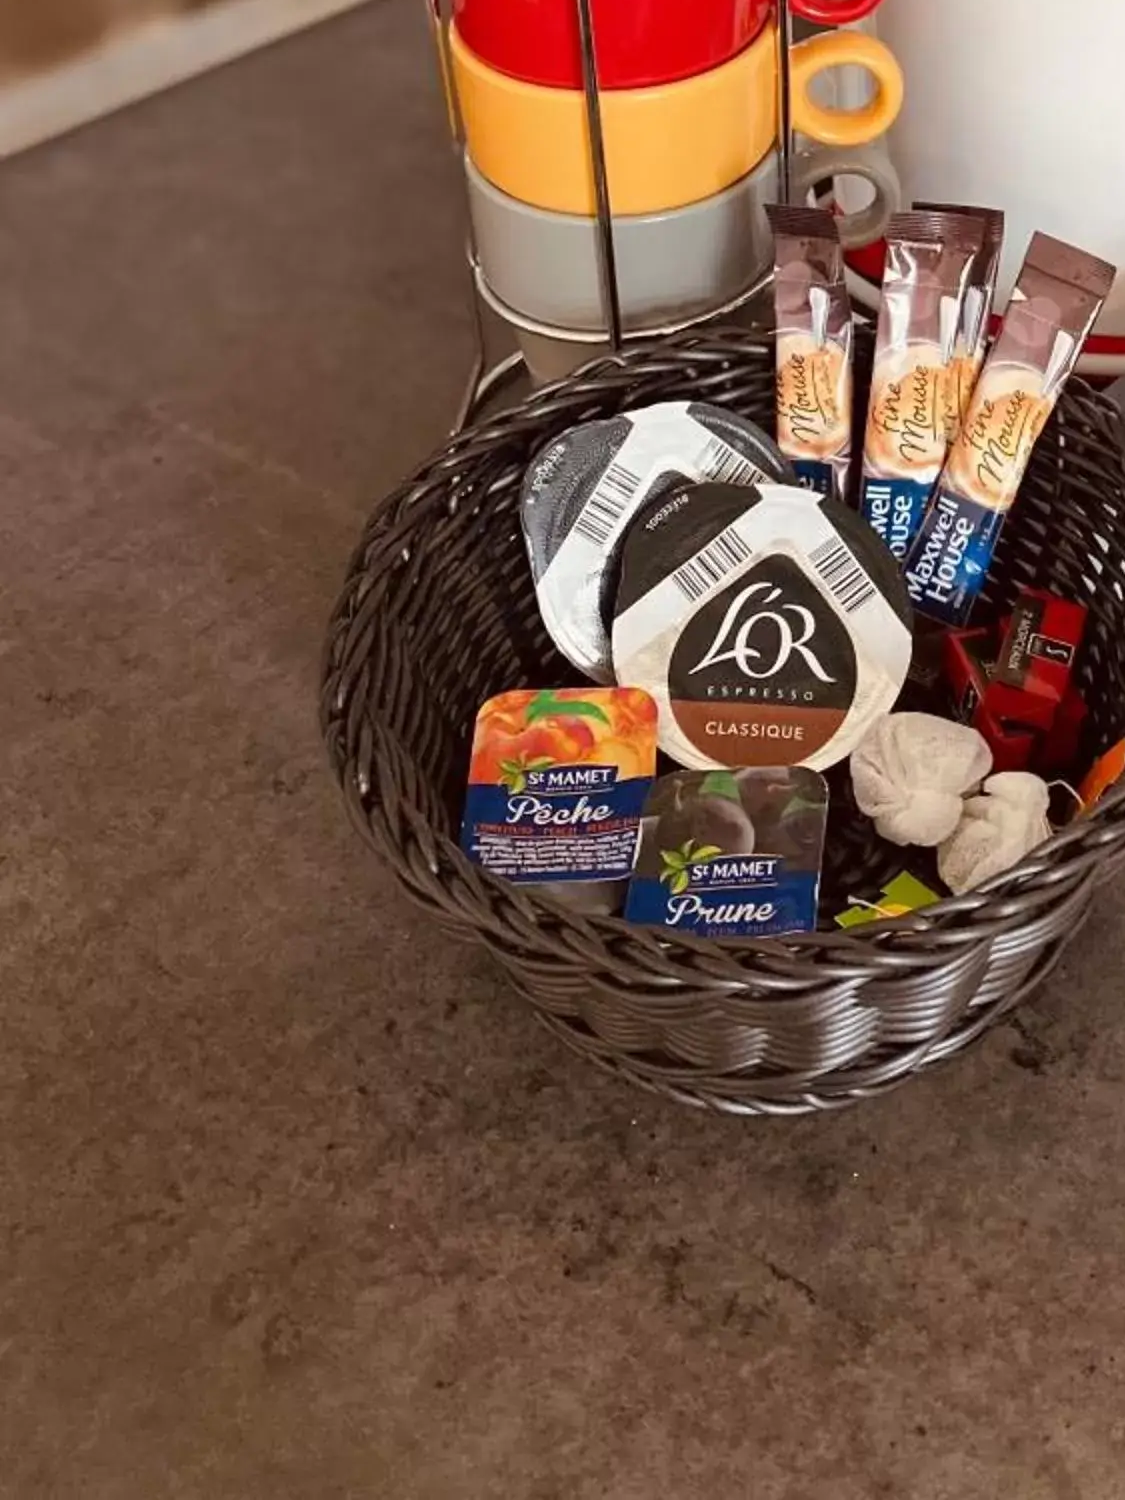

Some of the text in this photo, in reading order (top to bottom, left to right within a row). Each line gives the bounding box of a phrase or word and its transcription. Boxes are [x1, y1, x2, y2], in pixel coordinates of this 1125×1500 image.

[789, 353, 821, 444] Mousse
[871, 383, 901, 434] Fine
[899, 364, 932, 463] Mousse
[962, 399, 995, 451] Fine
[976, 389, 1026, 488] Mousse
[865, 485, 892, 539] well
[889, 495, 913, 563] ouse
[905, 496, 960, 602] Maxwell
[925, 516, 975, 604] House
[706, 685, 814, 701] ESPRESSO
[704, 720, 805, 741] CLASSIQUE
[527, 768, 612, 787] St MAMET
[505, 795, 615, 826] Pêche
[691, 864, 709, 881] St
[711, 859, 777, 879] MAMET
[664, 893, 779, 926] Prune
